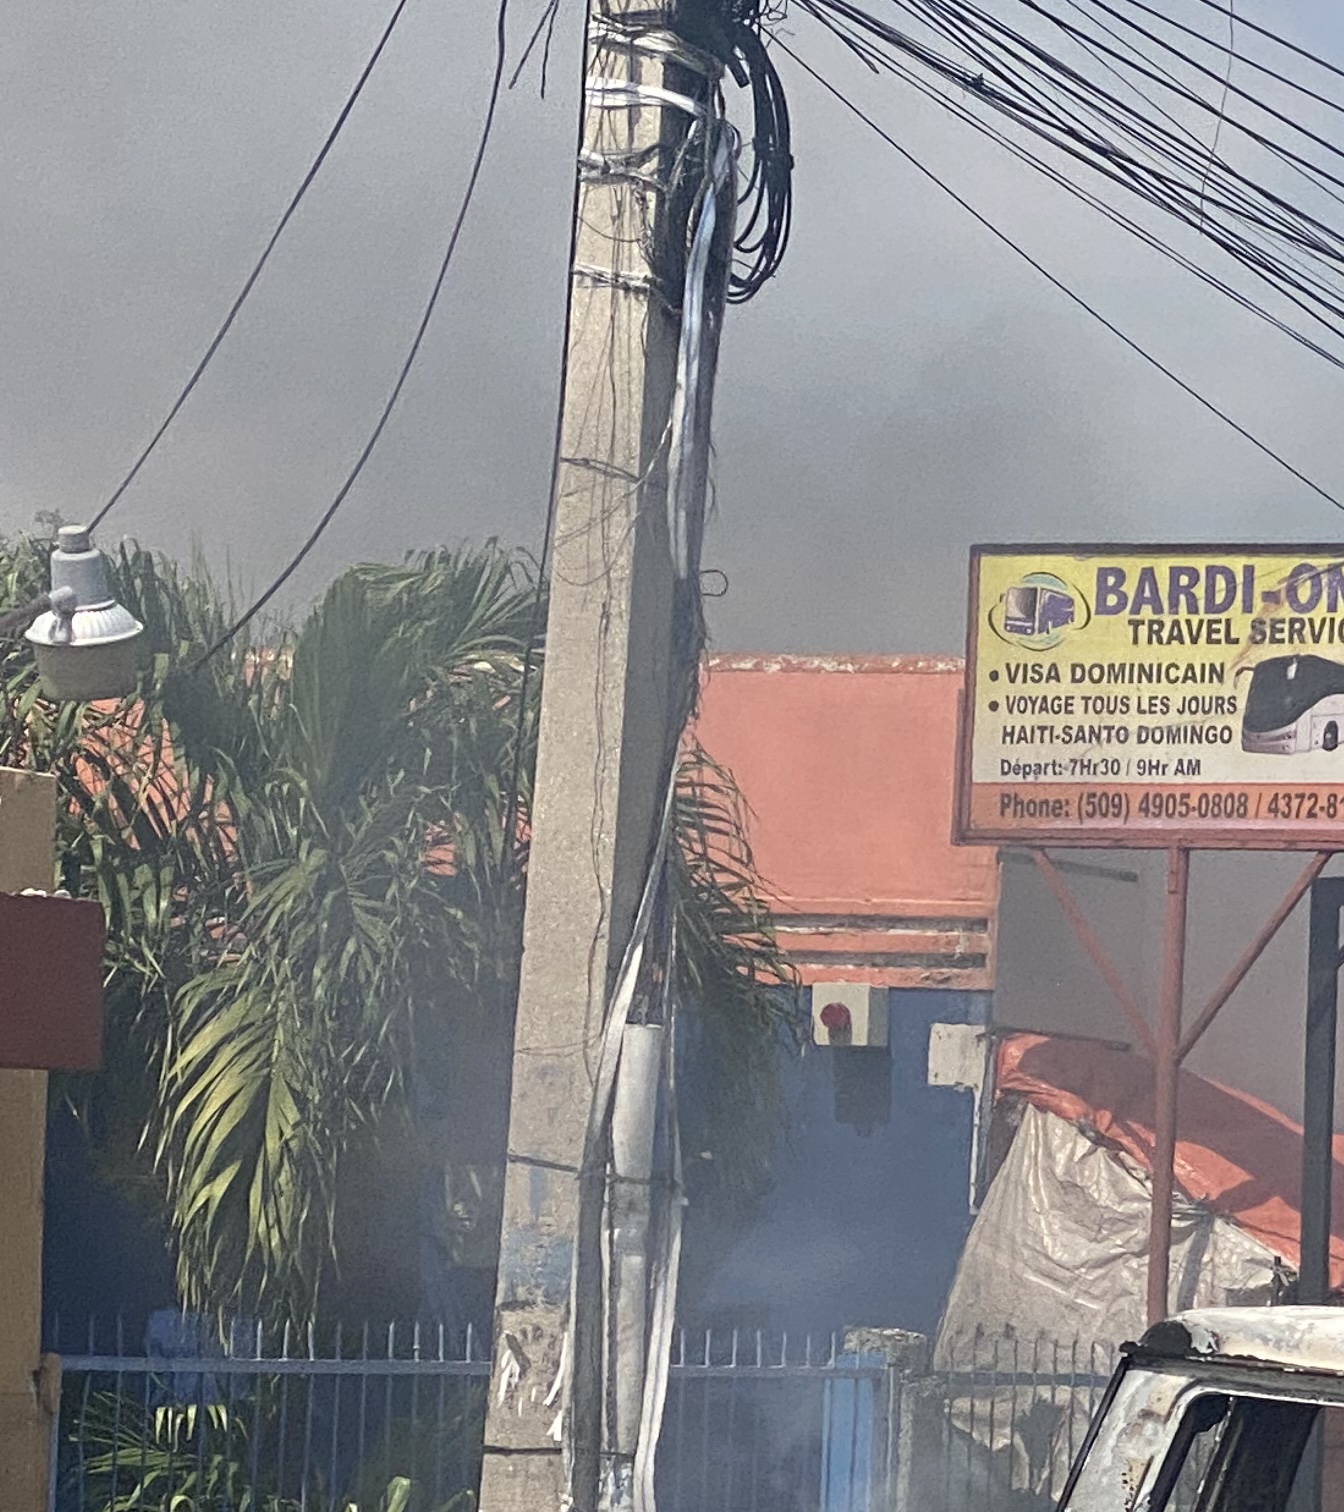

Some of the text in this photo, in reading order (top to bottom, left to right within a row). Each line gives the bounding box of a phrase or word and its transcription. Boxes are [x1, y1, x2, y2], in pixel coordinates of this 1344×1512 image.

[1128, 618, 1240, 645] TRAVEL
[1005, 661, 1225, 684] VISA DOMINICAIN
[1005, 695, 1238, 715] VOYAGE TOUS LES JOURS
[1002, 725, 1233, 745] HAITI-SANTO DOMINGO
[1000, 757, 1063, 780] Départ:
[1069, 758, 1121, 776] 7Hr30
[1136, 758, 1169, 776] 9Hr
[1173, 758, 1202, 776] AM
[1000, 792, 1070, 819] Phone:
[1077, 791, 1129, 825] (509)
[1138, 791, 1249, 819] 4905-0808
